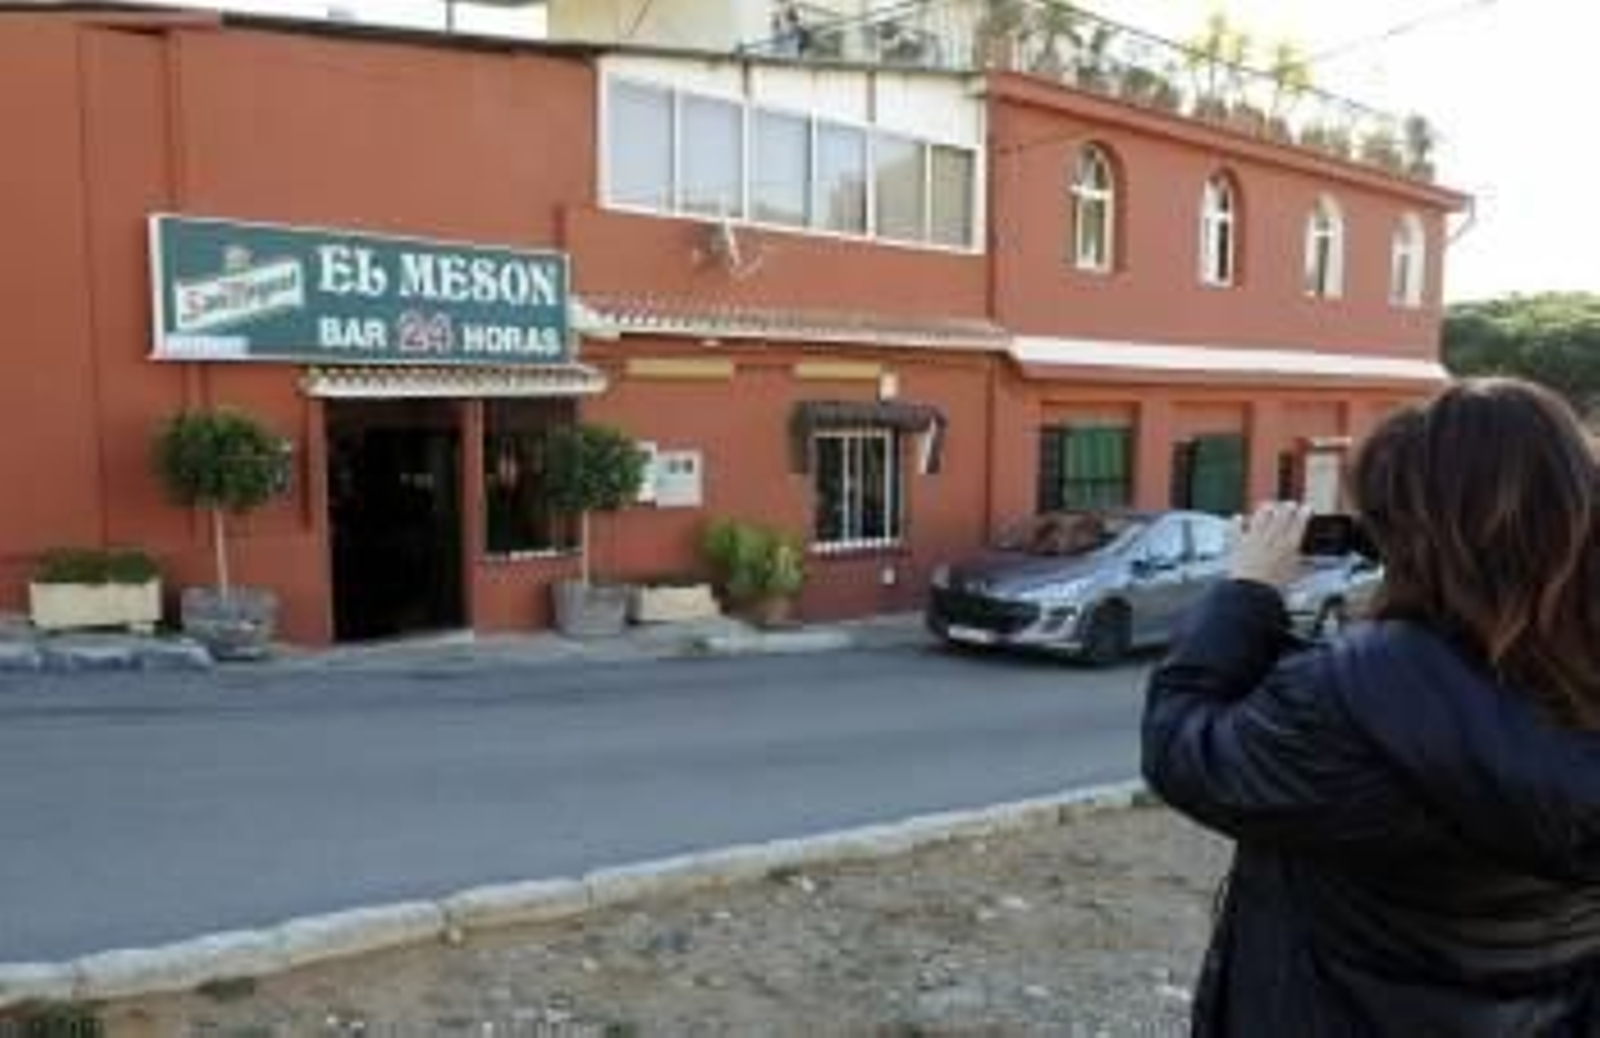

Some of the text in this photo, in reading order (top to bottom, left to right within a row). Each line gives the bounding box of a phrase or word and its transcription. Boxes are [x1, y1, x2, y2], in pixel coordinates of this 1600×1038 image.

[318, 244, 387, 297] EL
[400, 252, 558, 305] MESON
[320, 310, 561, 355] BAR 24 HORAS
